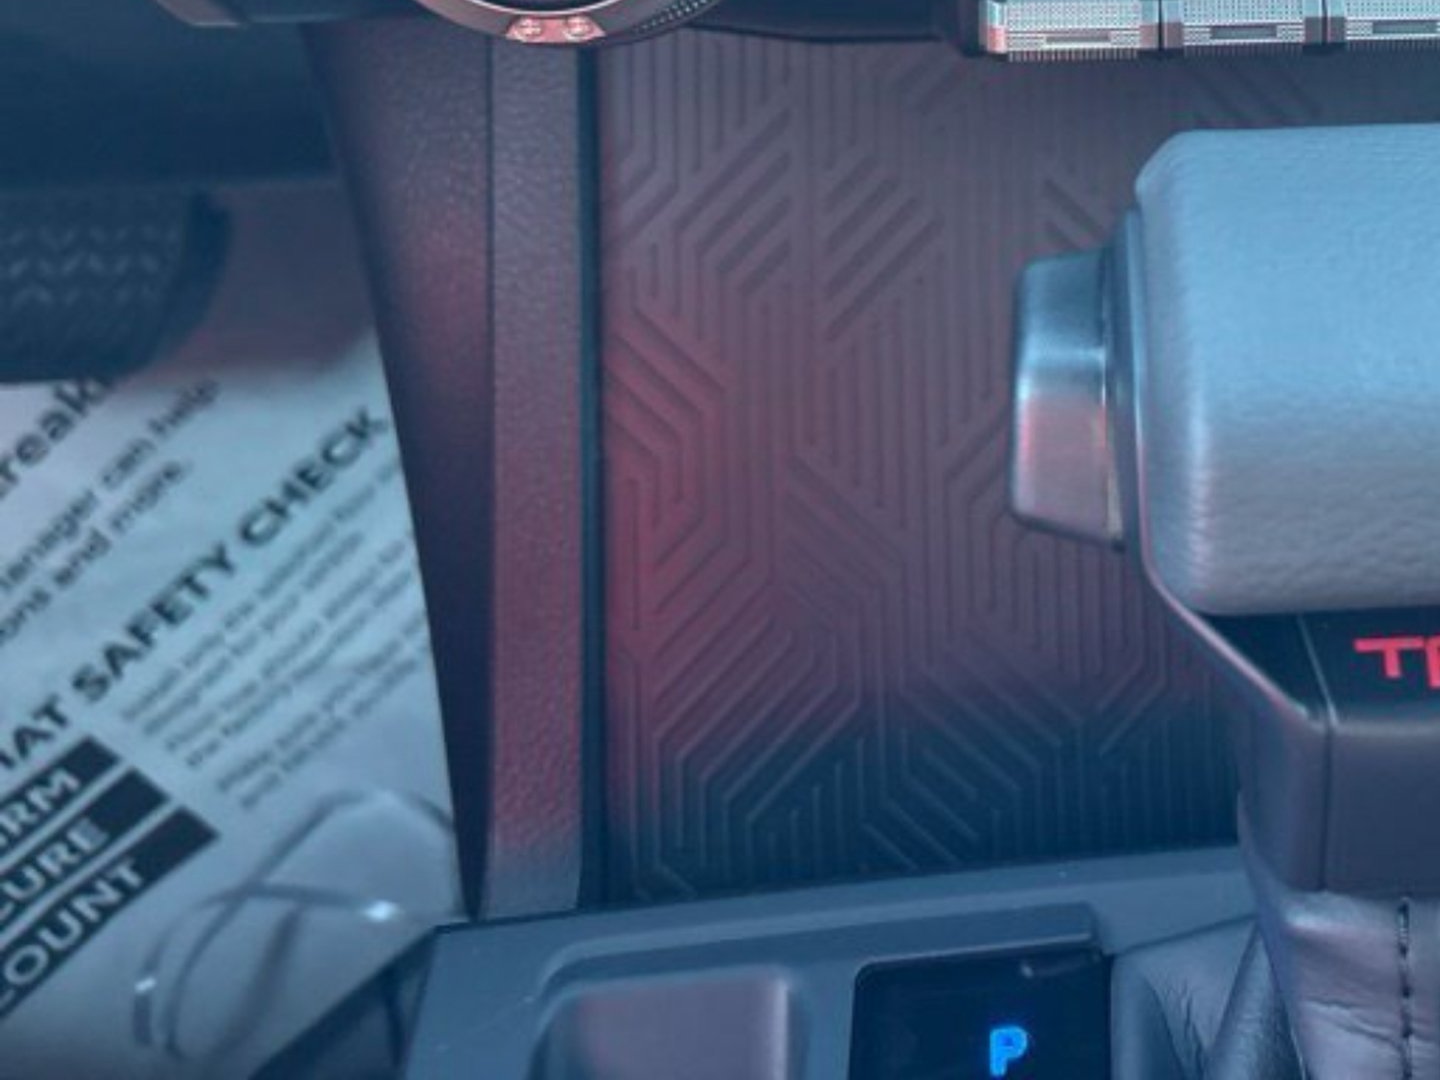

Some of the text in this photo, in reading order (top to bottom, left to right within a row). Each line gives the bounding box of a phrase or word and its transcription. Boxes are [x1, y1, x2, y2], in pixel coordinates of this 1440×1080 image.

[0, 380, 112, 500] reak
[0, 488, 99, 597] anager
[73, 538, 237, 703] SAFETY
[239, 405, 388, 546] CHECK
[989, 1026, 1028, 1076] P
